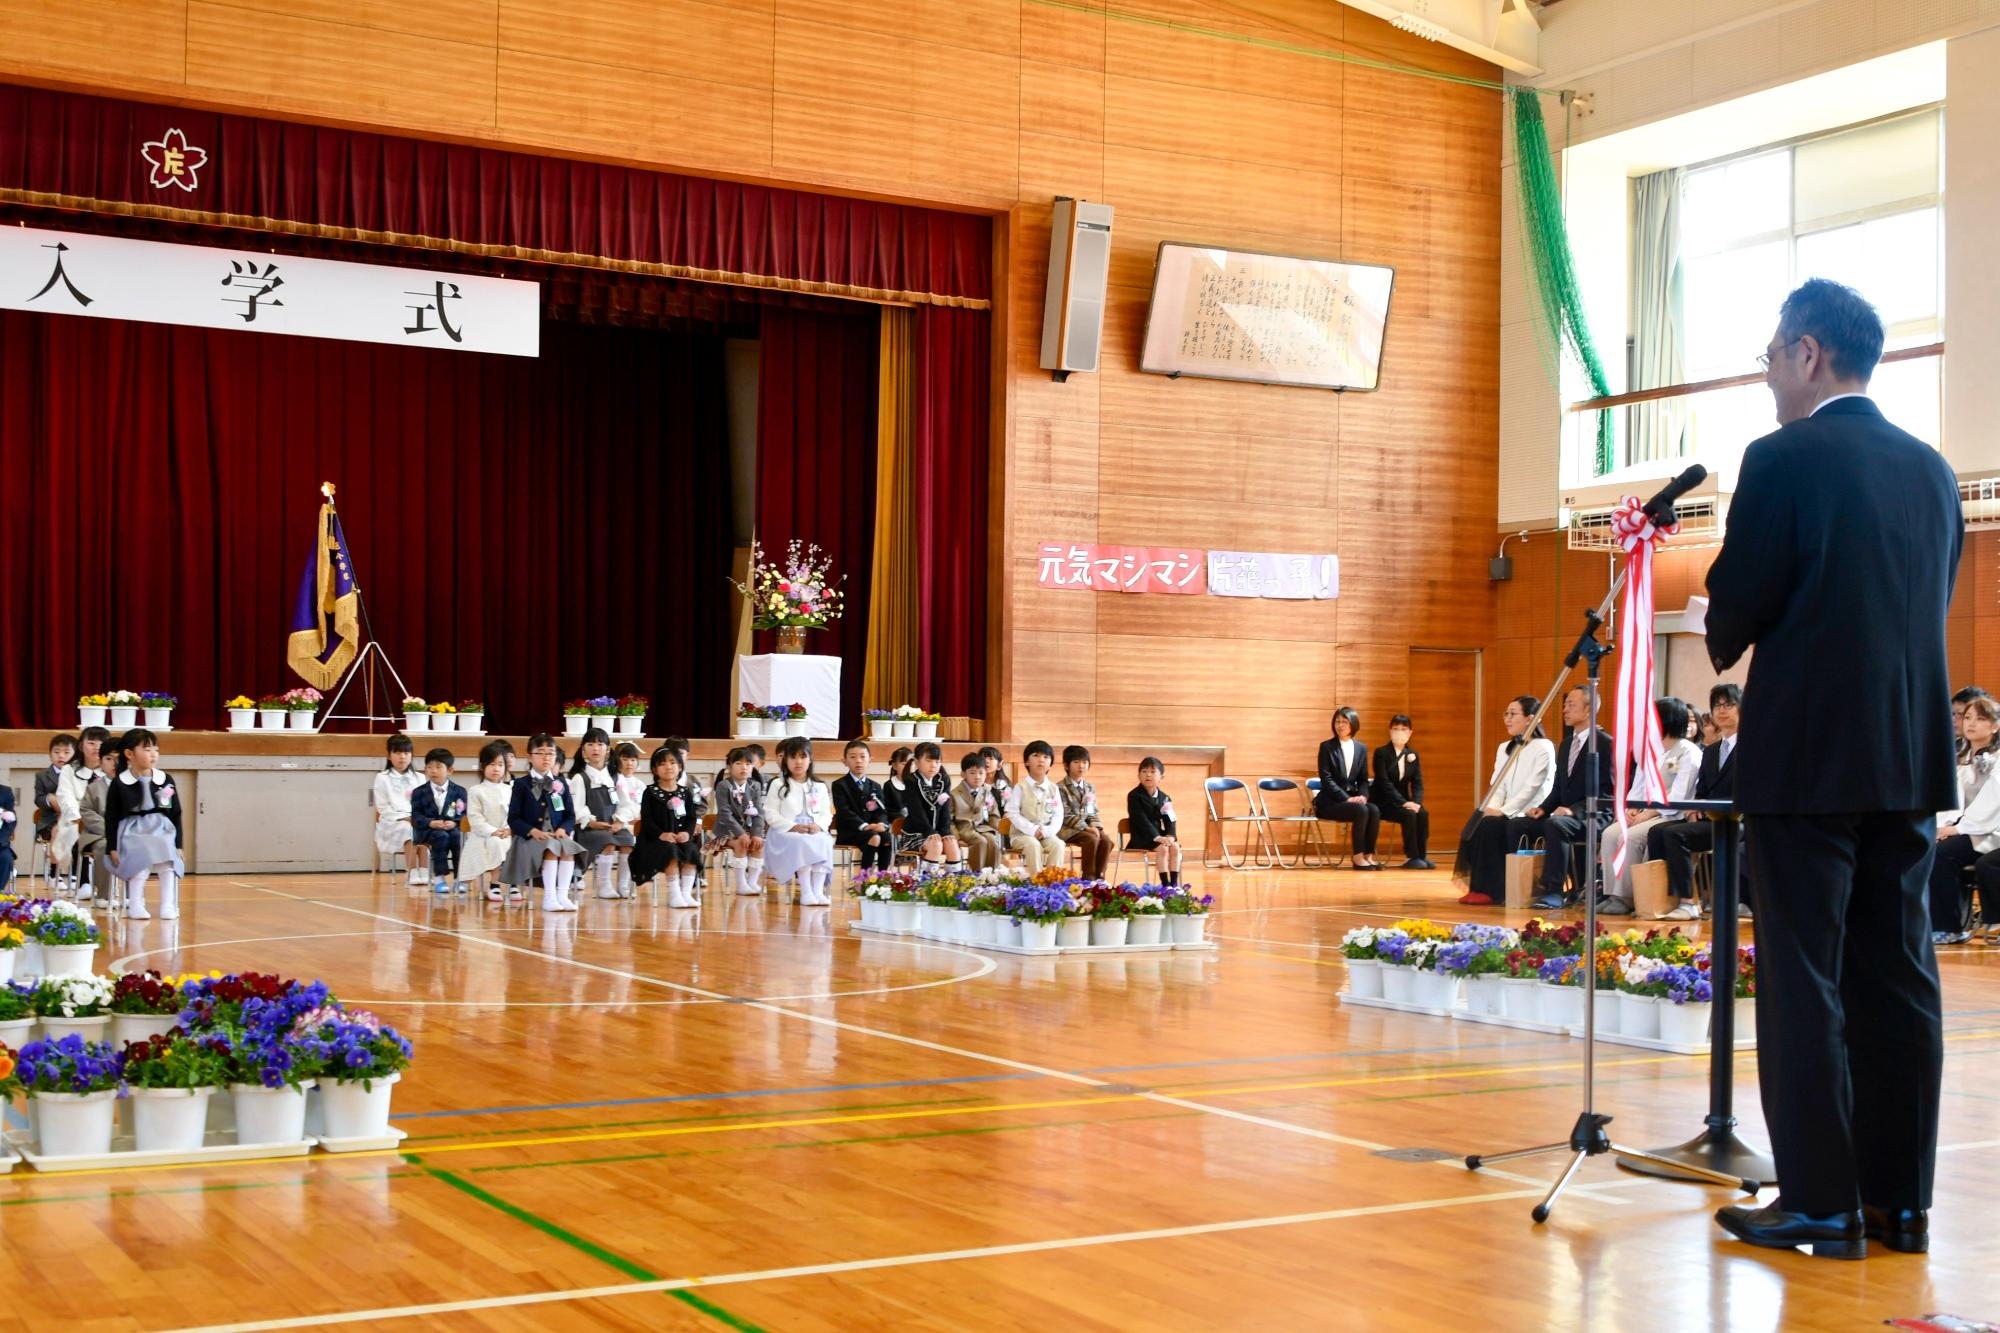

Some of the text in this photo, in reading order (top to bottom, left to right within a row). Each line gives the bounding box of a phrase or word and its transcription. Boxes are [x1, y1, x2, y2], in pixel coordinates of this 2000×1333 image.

[26, 242, 463, 343] 入学式
[1039, 545, 1202, 587] 元気マシマシ
